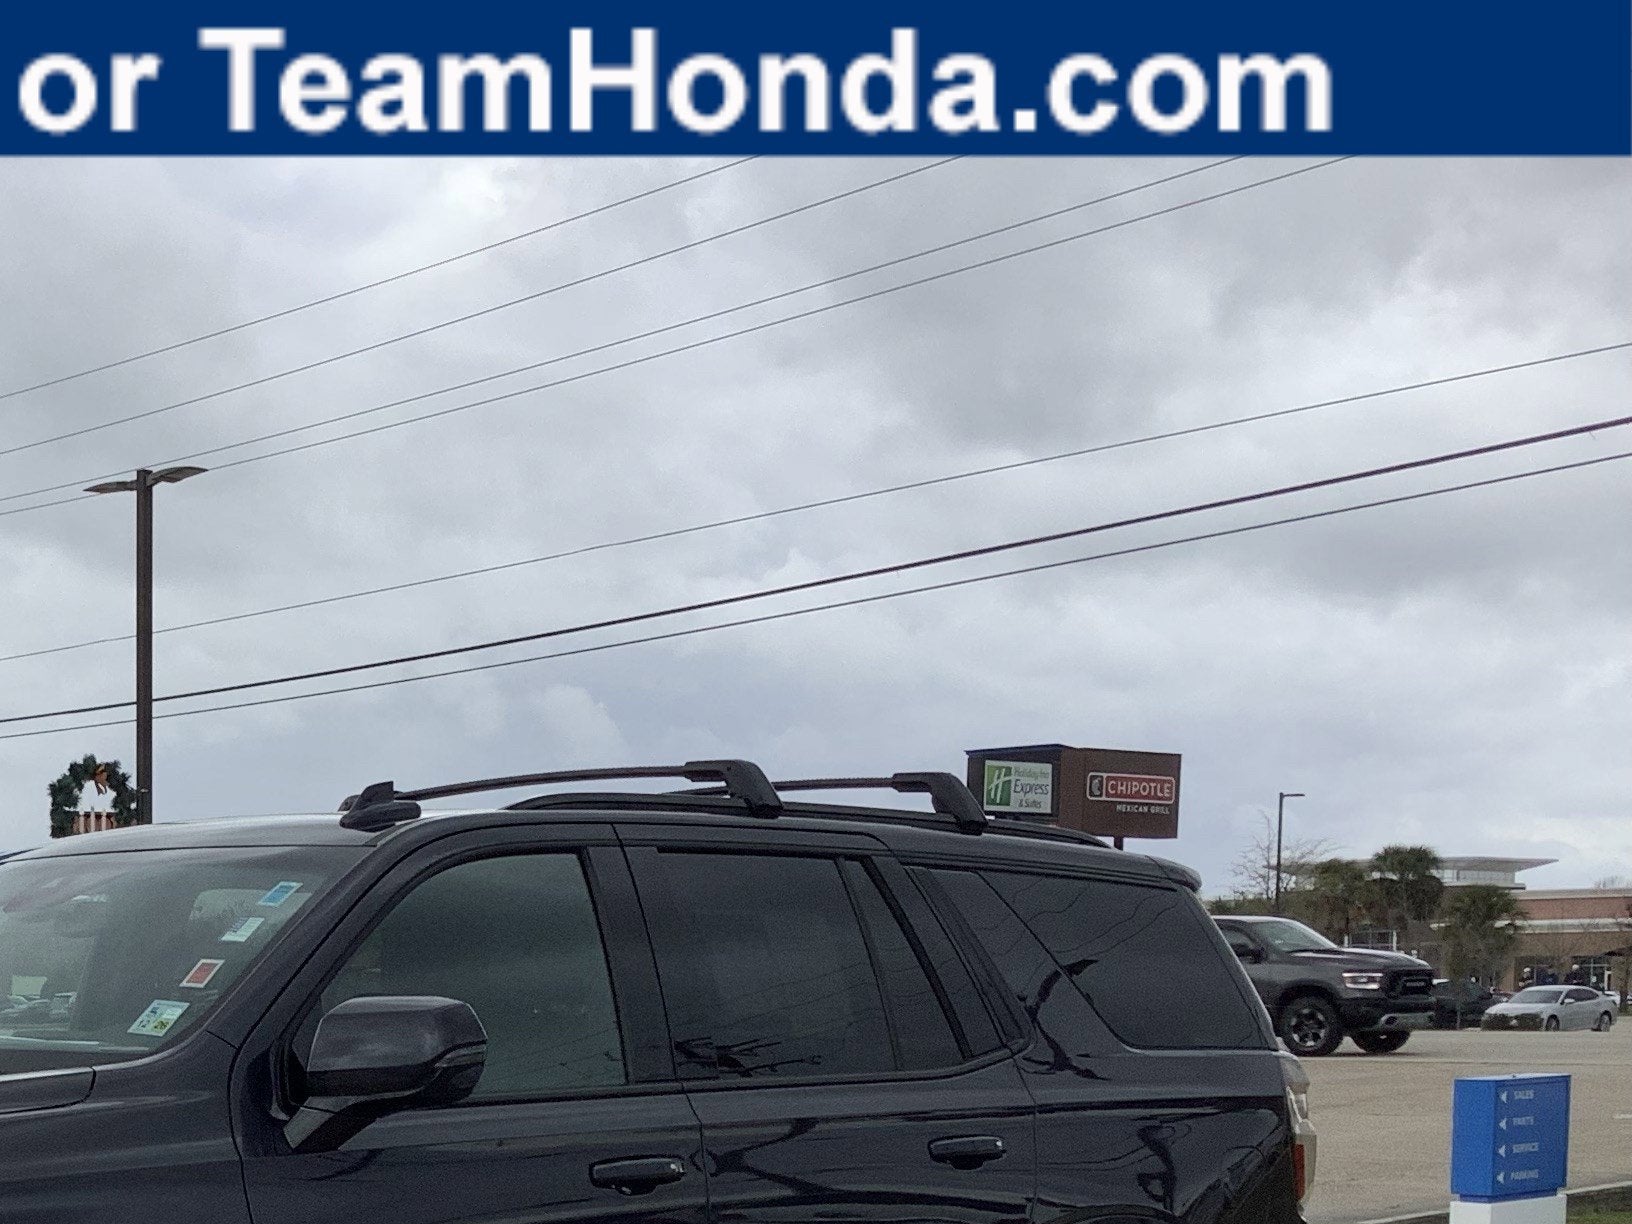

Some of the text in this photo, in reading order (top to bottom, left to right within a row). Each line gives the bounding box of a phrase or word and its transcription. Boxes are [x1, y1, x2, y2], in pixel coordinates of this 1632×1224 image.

[1013, 779, 1049, 797] Express
[1108, 780, 1172, 797] CHIPOTLE
[1116, 804, 1170, 815] MEXICAN GRILL
